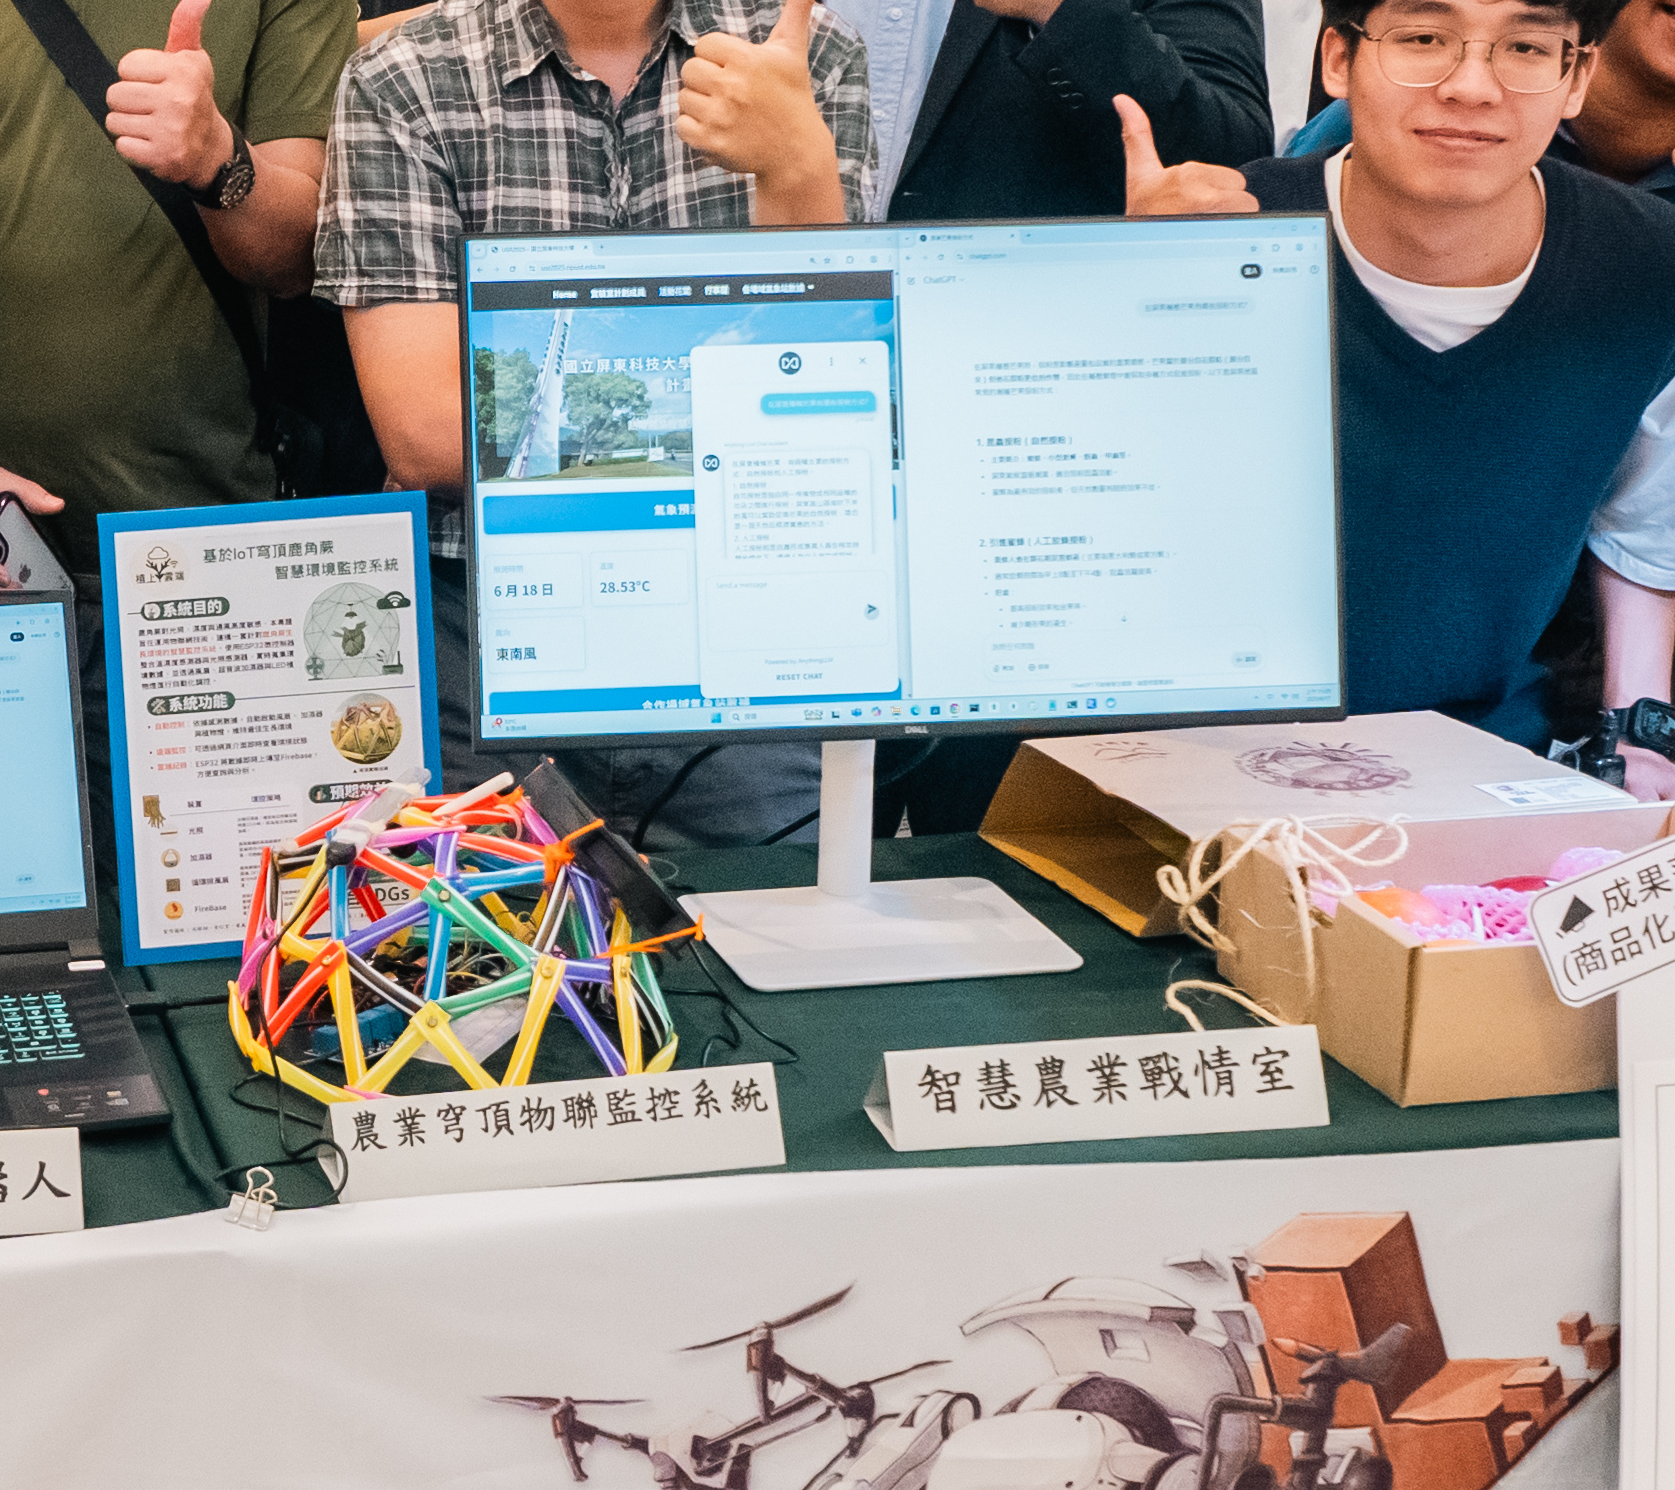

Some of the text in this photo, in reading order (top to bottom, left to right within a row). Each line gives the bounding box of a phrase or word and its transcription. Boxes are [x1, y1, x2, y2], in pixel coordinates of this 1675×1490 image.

[494, 583, 553, 597] 6 月 18 日
[600, 580, 650, 593] 28.53°C
[162, 599, 223, 617] 系統目的
[496, 647, 537, 661] 東南風
[169, 694, 228, 712] 系統功能
[917, 1044, 1296, 1115] 智慧農業戰情室
[350, 1078, 770, 1152] 農業穹頂物聯監控系統
